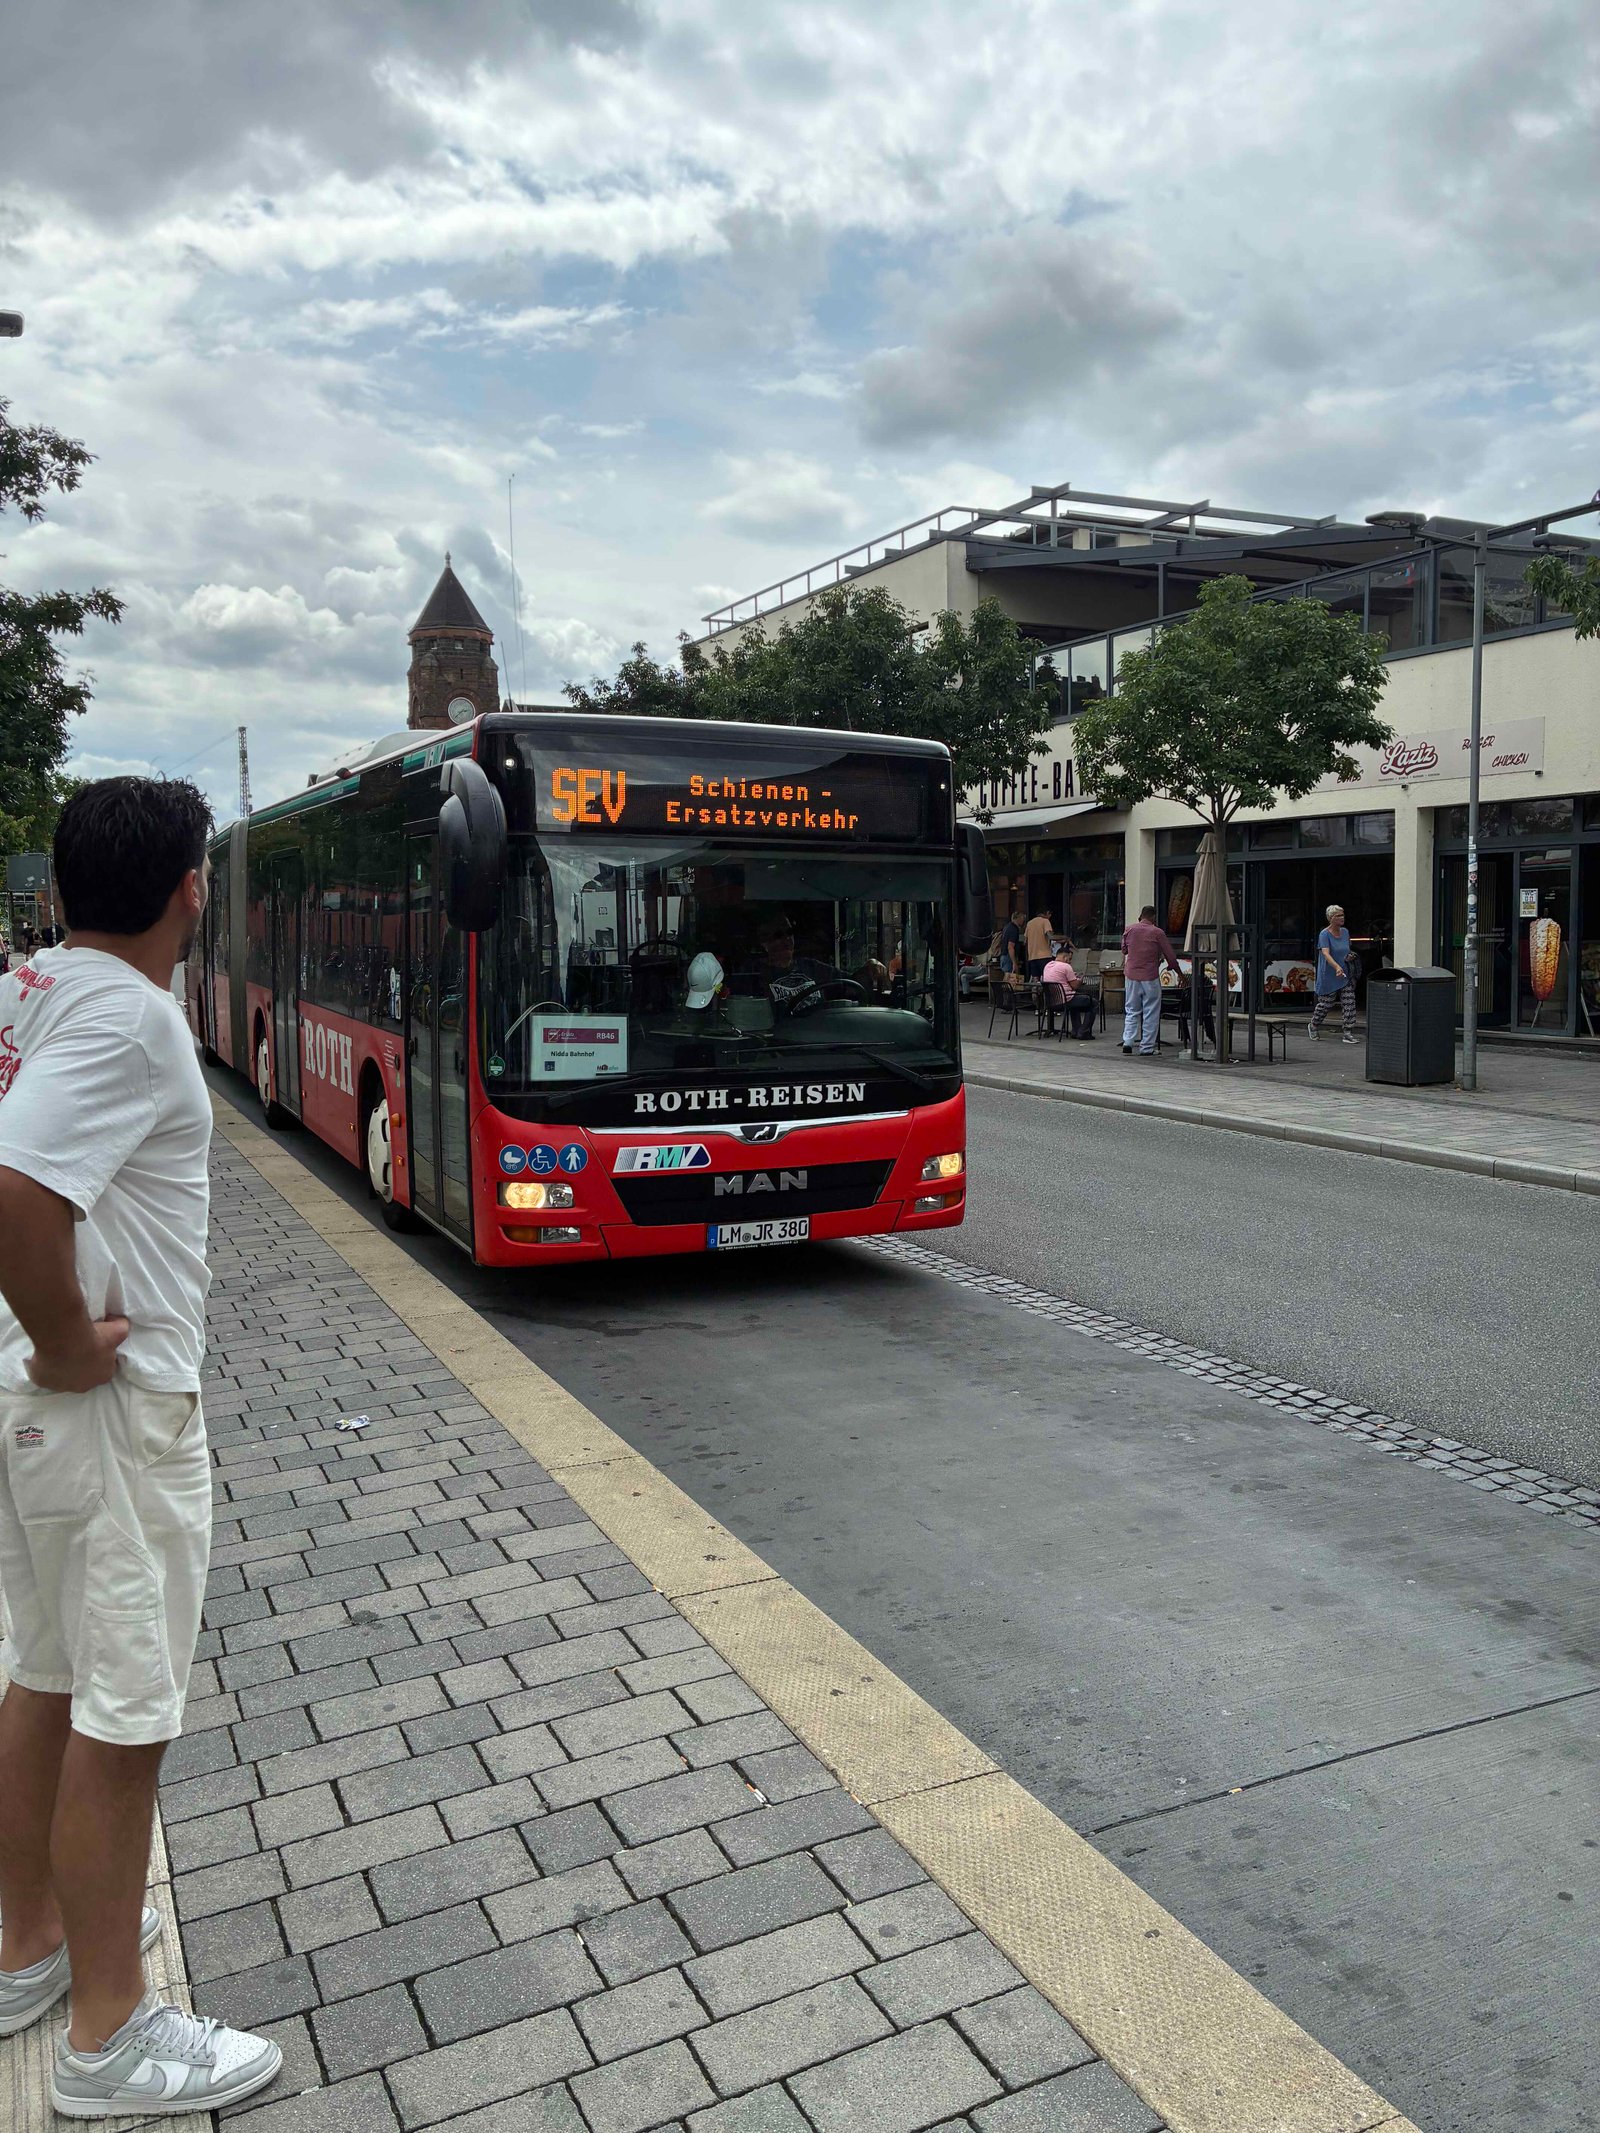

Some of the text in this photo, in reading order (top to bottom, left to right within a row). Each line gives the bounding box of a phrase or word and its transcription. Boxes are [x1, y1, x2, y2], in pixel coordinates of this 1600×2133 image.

[1462, 735, 1496, 751] BGER
[1380, 740, 1439, 776] Laziz
[1491, 752, 1530, 768] CHICKEN
[552, 767, 626, 823] SEV
[690, 775, 809, 801] Schienen
[979, 758, 1090, 809] COFFEE-BA
[666, 800, 859, 829] Ersatzverkehr
[596, 1032, 615, 1040] RB46
[303, 1018, 354, 1097] ROTH
[634, 1082, 866, 1113] ROTH-REISEN
[632, 1145, 701, 1170] RMV
[714, 1170, 808, 1196] MAN
[718, 1225, 742, 1245] LM
[752, 1223, 773, 1241] JR
[778, 1219, 808, 1239] 380
